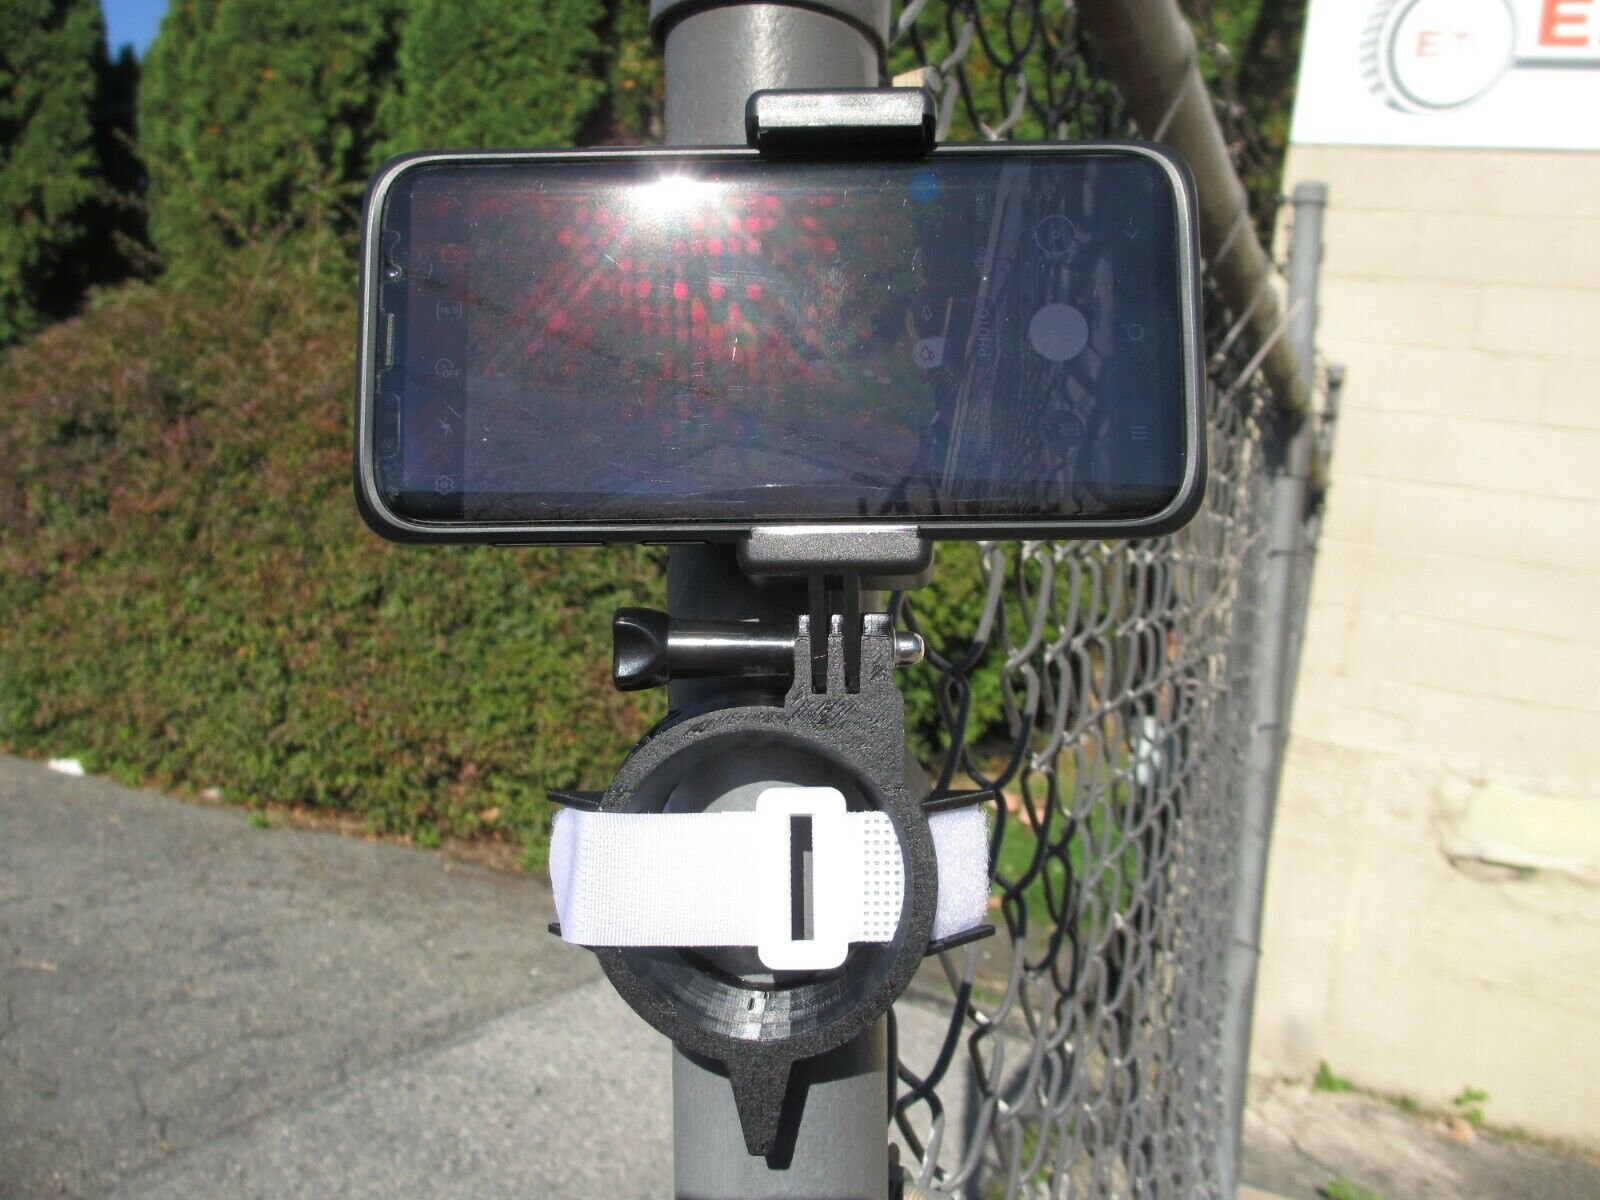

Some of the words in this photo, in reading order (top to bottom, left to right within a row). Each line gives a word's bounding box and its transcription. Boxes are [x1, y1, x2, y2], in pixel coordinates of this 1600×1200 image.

[1537, 0, 1600, 47] E
[976, 191, 986, 222] MORE
[977, 307, 990, 357] PHOTO
[442, 368, 464, 377] OFF
